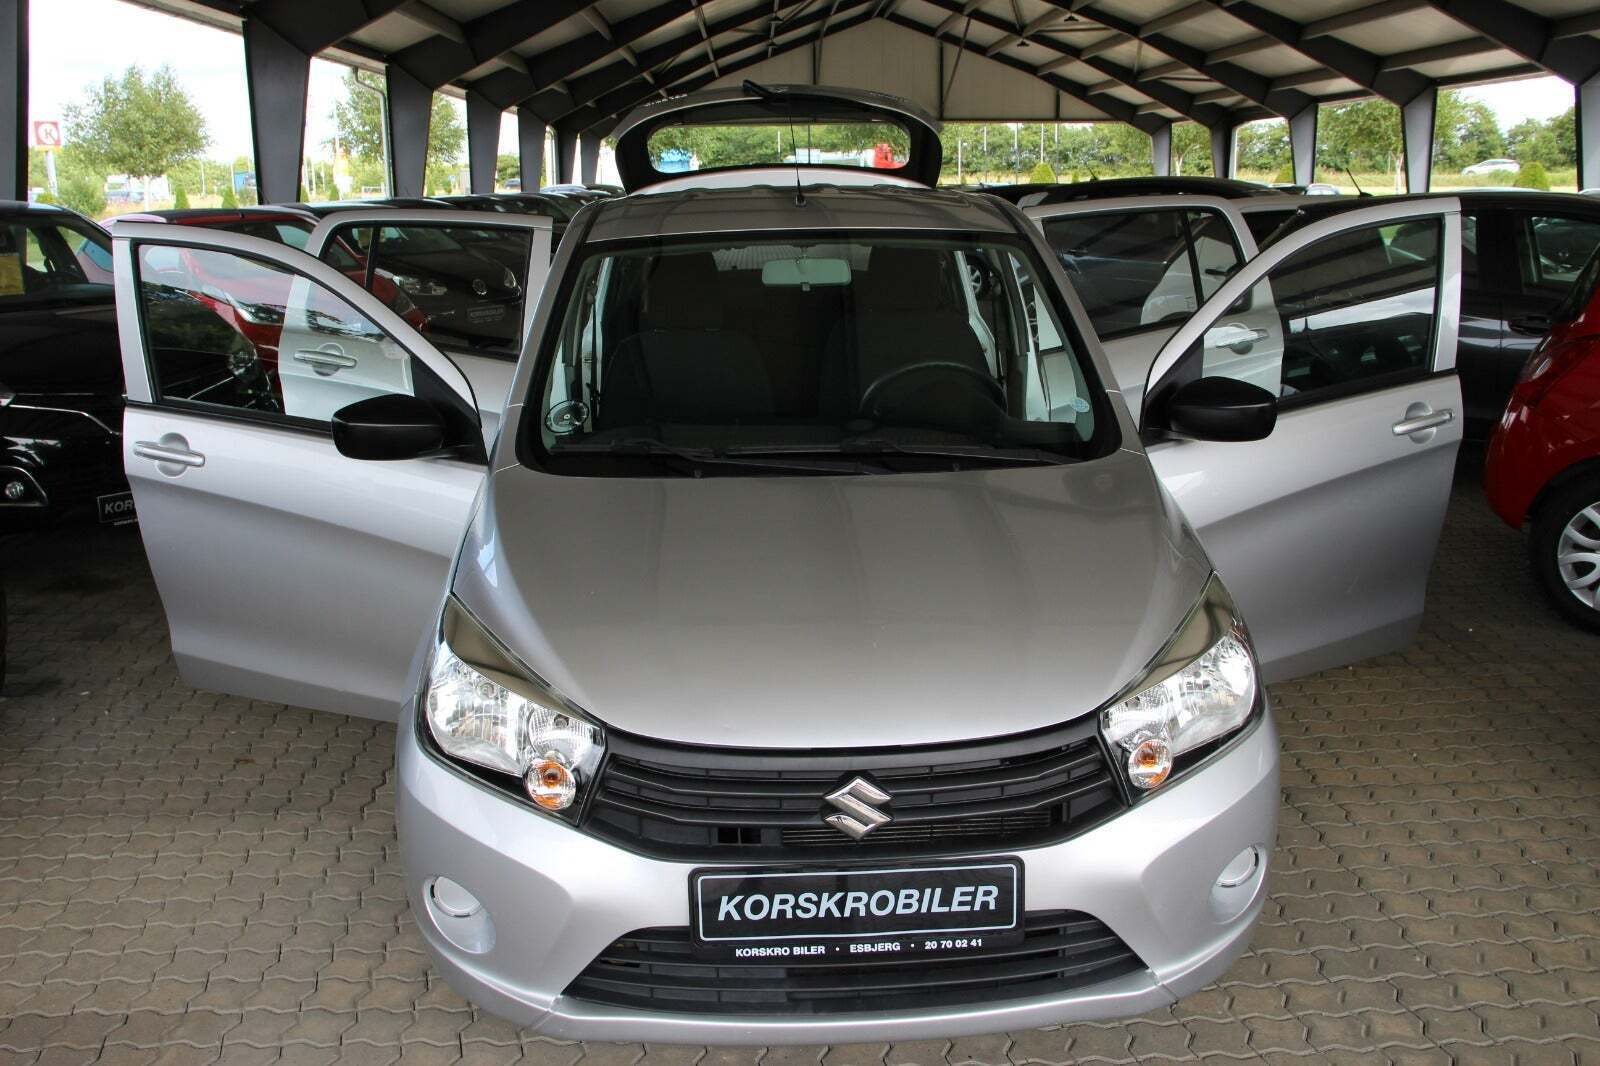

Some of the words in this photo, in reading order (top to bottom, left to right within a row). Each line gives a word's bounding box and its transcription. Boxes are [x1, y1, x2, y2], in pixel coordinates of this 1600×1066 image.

[718, 885, 999, 921] KORSKROBILER
[735, 947, 790, 957] KORSKRO
[793, 945, 826, 955] BILER
[849, 942, 901, 953] ESBJERG
[924, 941, 938, 950] 20
[940, 940, 952, 949] 70
[955, 939, 968, 948] 02
[970, 938, 983, 947] 41
